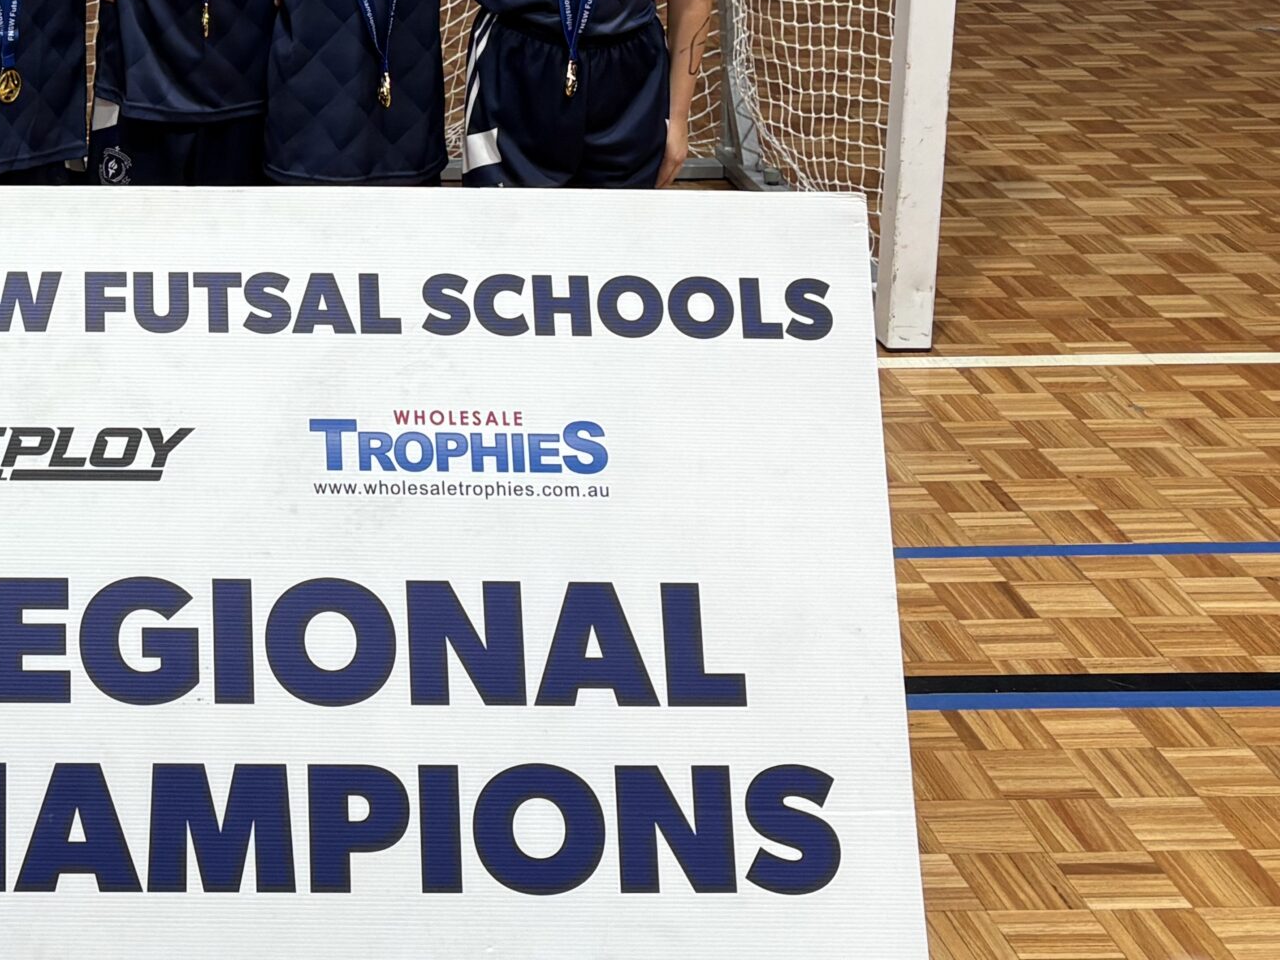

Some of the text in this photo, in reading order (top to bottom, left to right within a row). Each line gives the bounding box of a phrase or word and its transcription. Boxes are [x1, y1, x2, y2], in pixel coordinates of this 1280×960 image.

[7, 18, 15, 41] FNSW
[85, 271, 402, 335] FUTSAL
[421, 273, 834, 341] SCHOOLS
[393, 410, 523, 426] WHOLESALE
[309, 418, 609, 475] TROPHIES
[313, 480, 610, 500] www.wholesaletrophies.com.au
